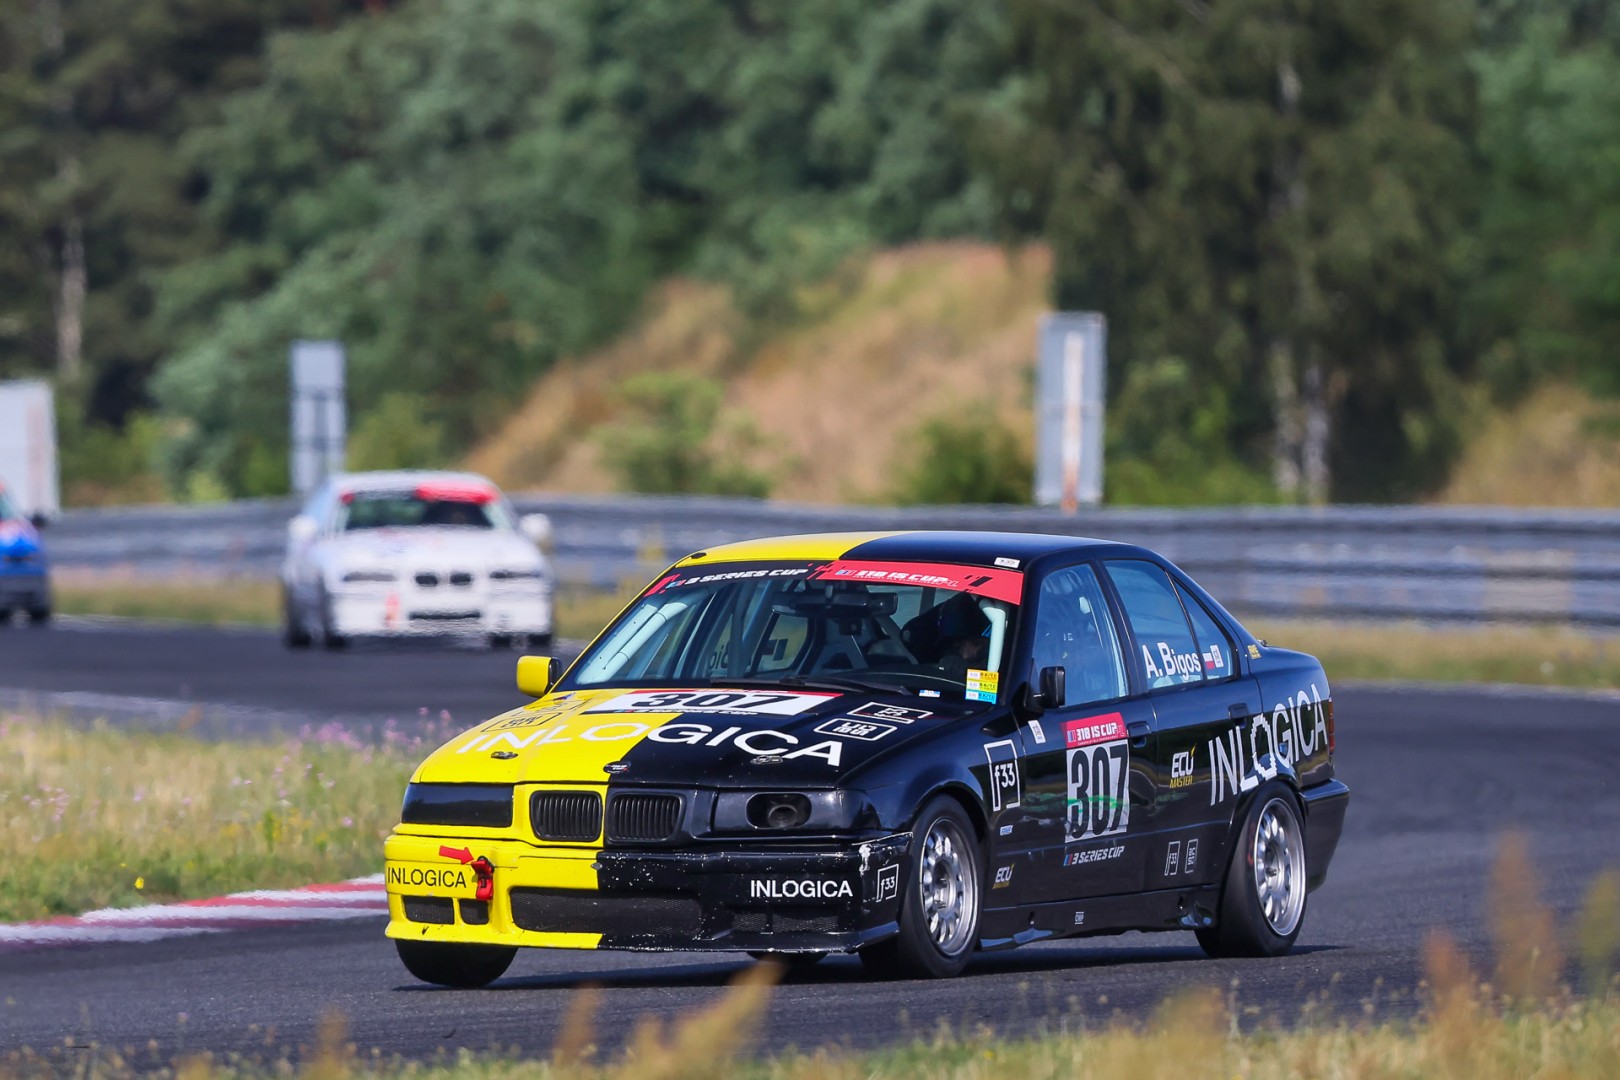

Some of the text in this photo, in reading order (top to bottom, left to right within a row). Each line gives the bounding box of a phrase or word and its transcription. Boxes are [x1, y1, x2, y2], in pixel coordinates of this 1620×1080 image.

[700, 570, 769, 583] SERIES
[769, 568, 808, 576] CUP
[908, 574, 949, 584] CUP
[631, 693, 798, 709] 307
[1077, 727, 1091, 741] 318
[1090, 725, 1101, 738] IS
[1100, 722, 1118, 737] CUP
[456, 722, 842, 767] INLOGICA
[1208, 684, 1328, 806] INLOGICA
[1172, 751, 1194, 778] ECU
[1170, 775, 1193, 788] MASTER
[1071, 744, 1127, 839] 307
[1072, 845, 1125, 865] 3 SERIES CUP
[387, 867, 467, 888] INLOGICA
[995, 866, 1012, 883] ECU
[750, 880, 853, 898] INLOGICA
